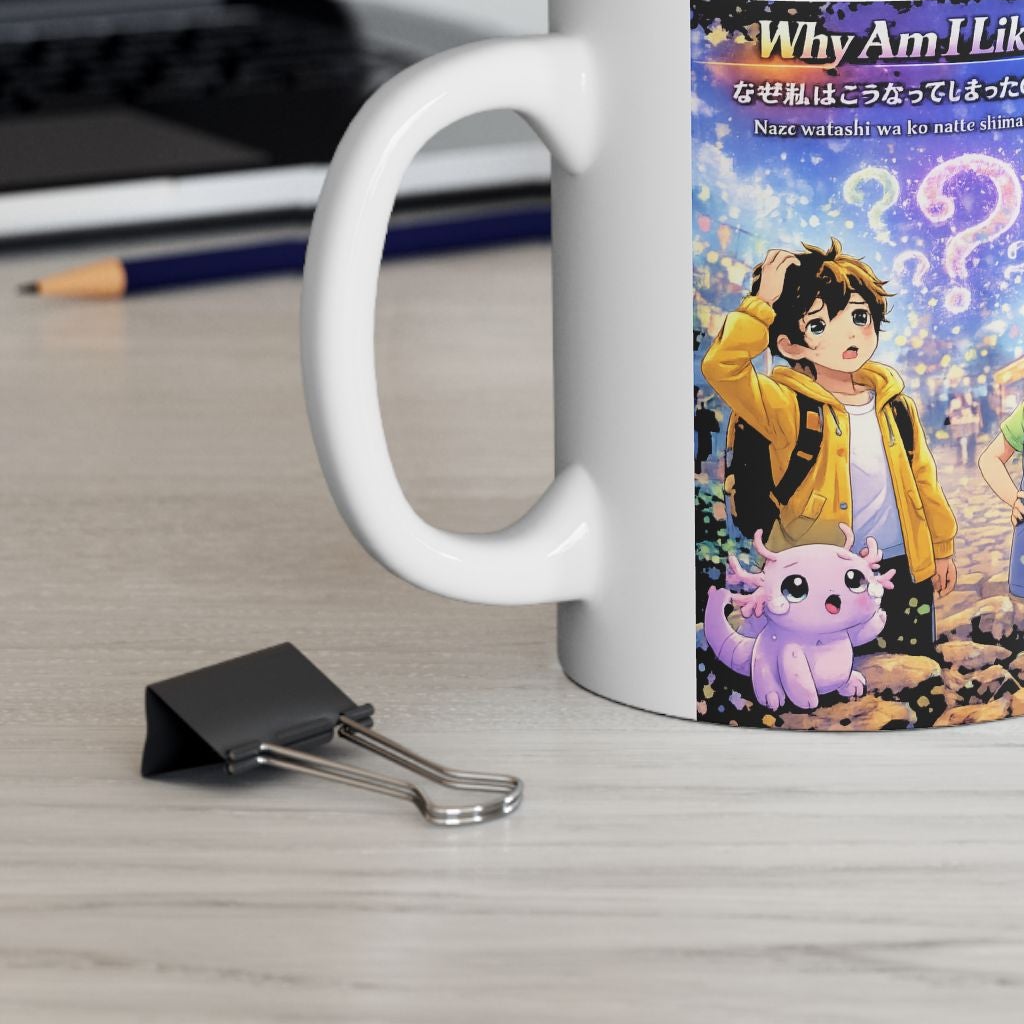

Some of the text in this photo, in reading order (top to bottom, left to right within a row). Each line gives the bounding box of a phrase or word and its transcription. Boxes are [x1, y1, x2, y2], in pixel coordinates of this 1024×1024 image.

[758, 19, 853, 68] Why
[863, 20, 938, 60] Am
[941, 18, 966, 57] I
[801, 118, 871, 136] watashi
[877, 124, 902, 136] wa
[906, 120, 928, 136] ko
[934, 118, 975, 134] natte
